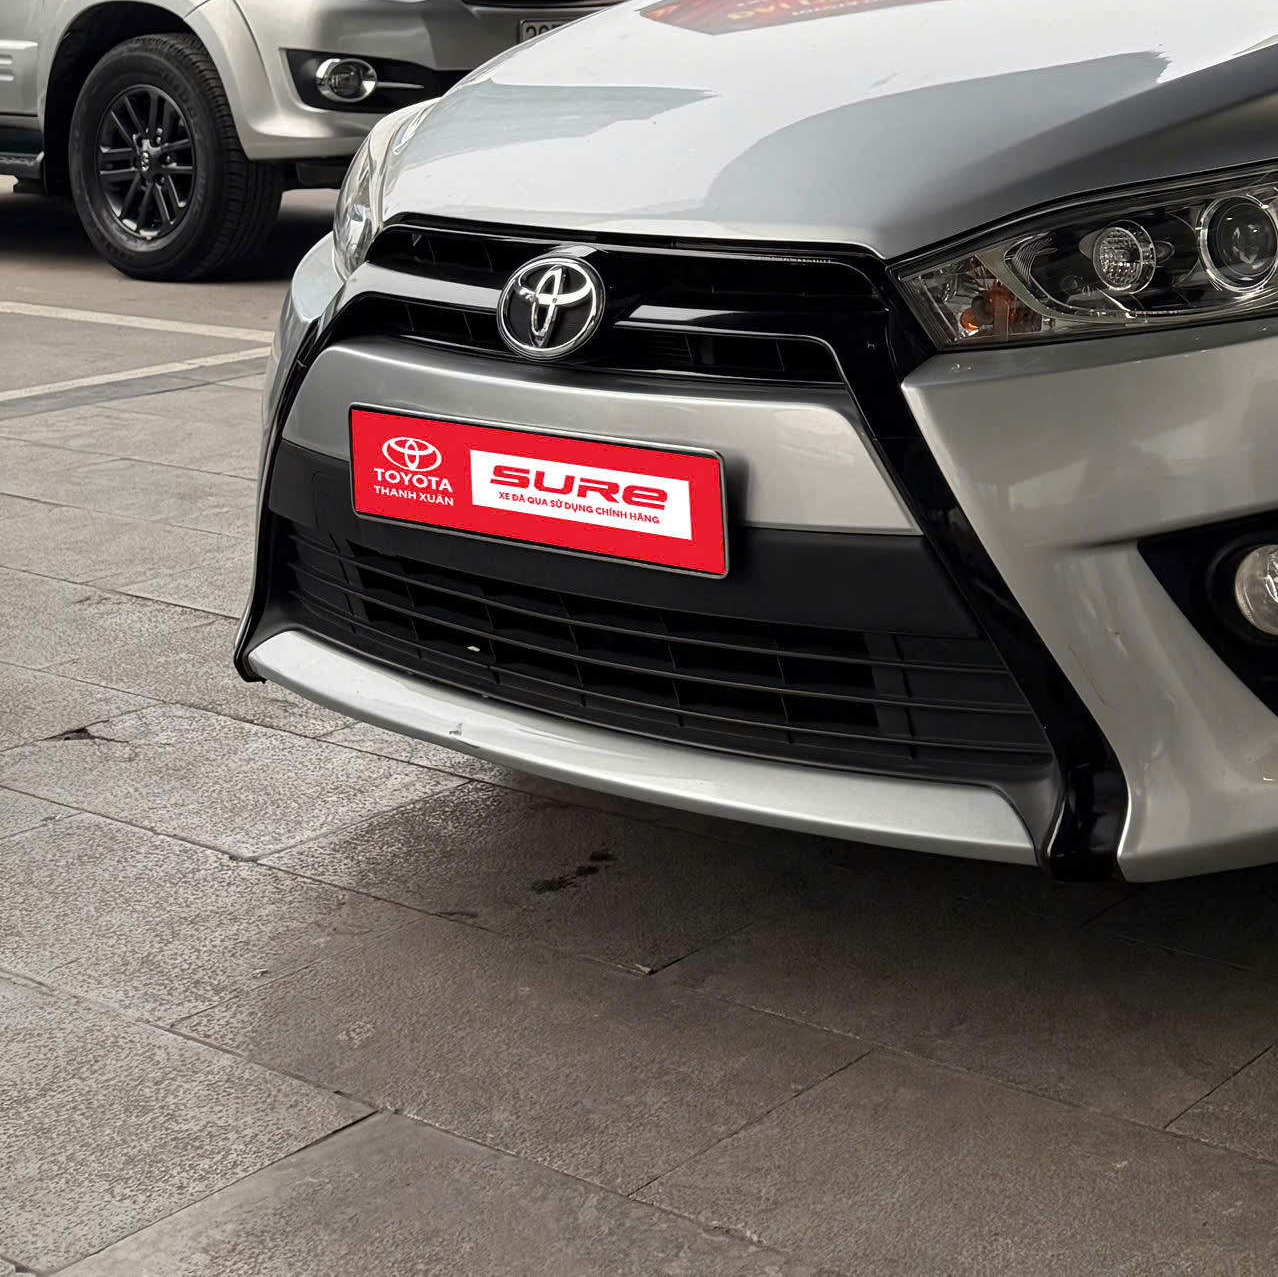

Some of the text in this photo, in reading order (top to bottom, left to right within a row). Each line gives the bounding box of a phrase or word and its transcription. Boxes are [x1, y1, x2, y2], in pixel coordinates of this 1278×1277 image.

[373, 467, 453, 493] TOYOTA
[490, 464, 668, 511] SURE
[373, 485, 454, 507] THANH XUÂN
[498, 491, 661, 524] XE ĐÃ QUA SỬ DỤNG CHÍNH HÃNG
